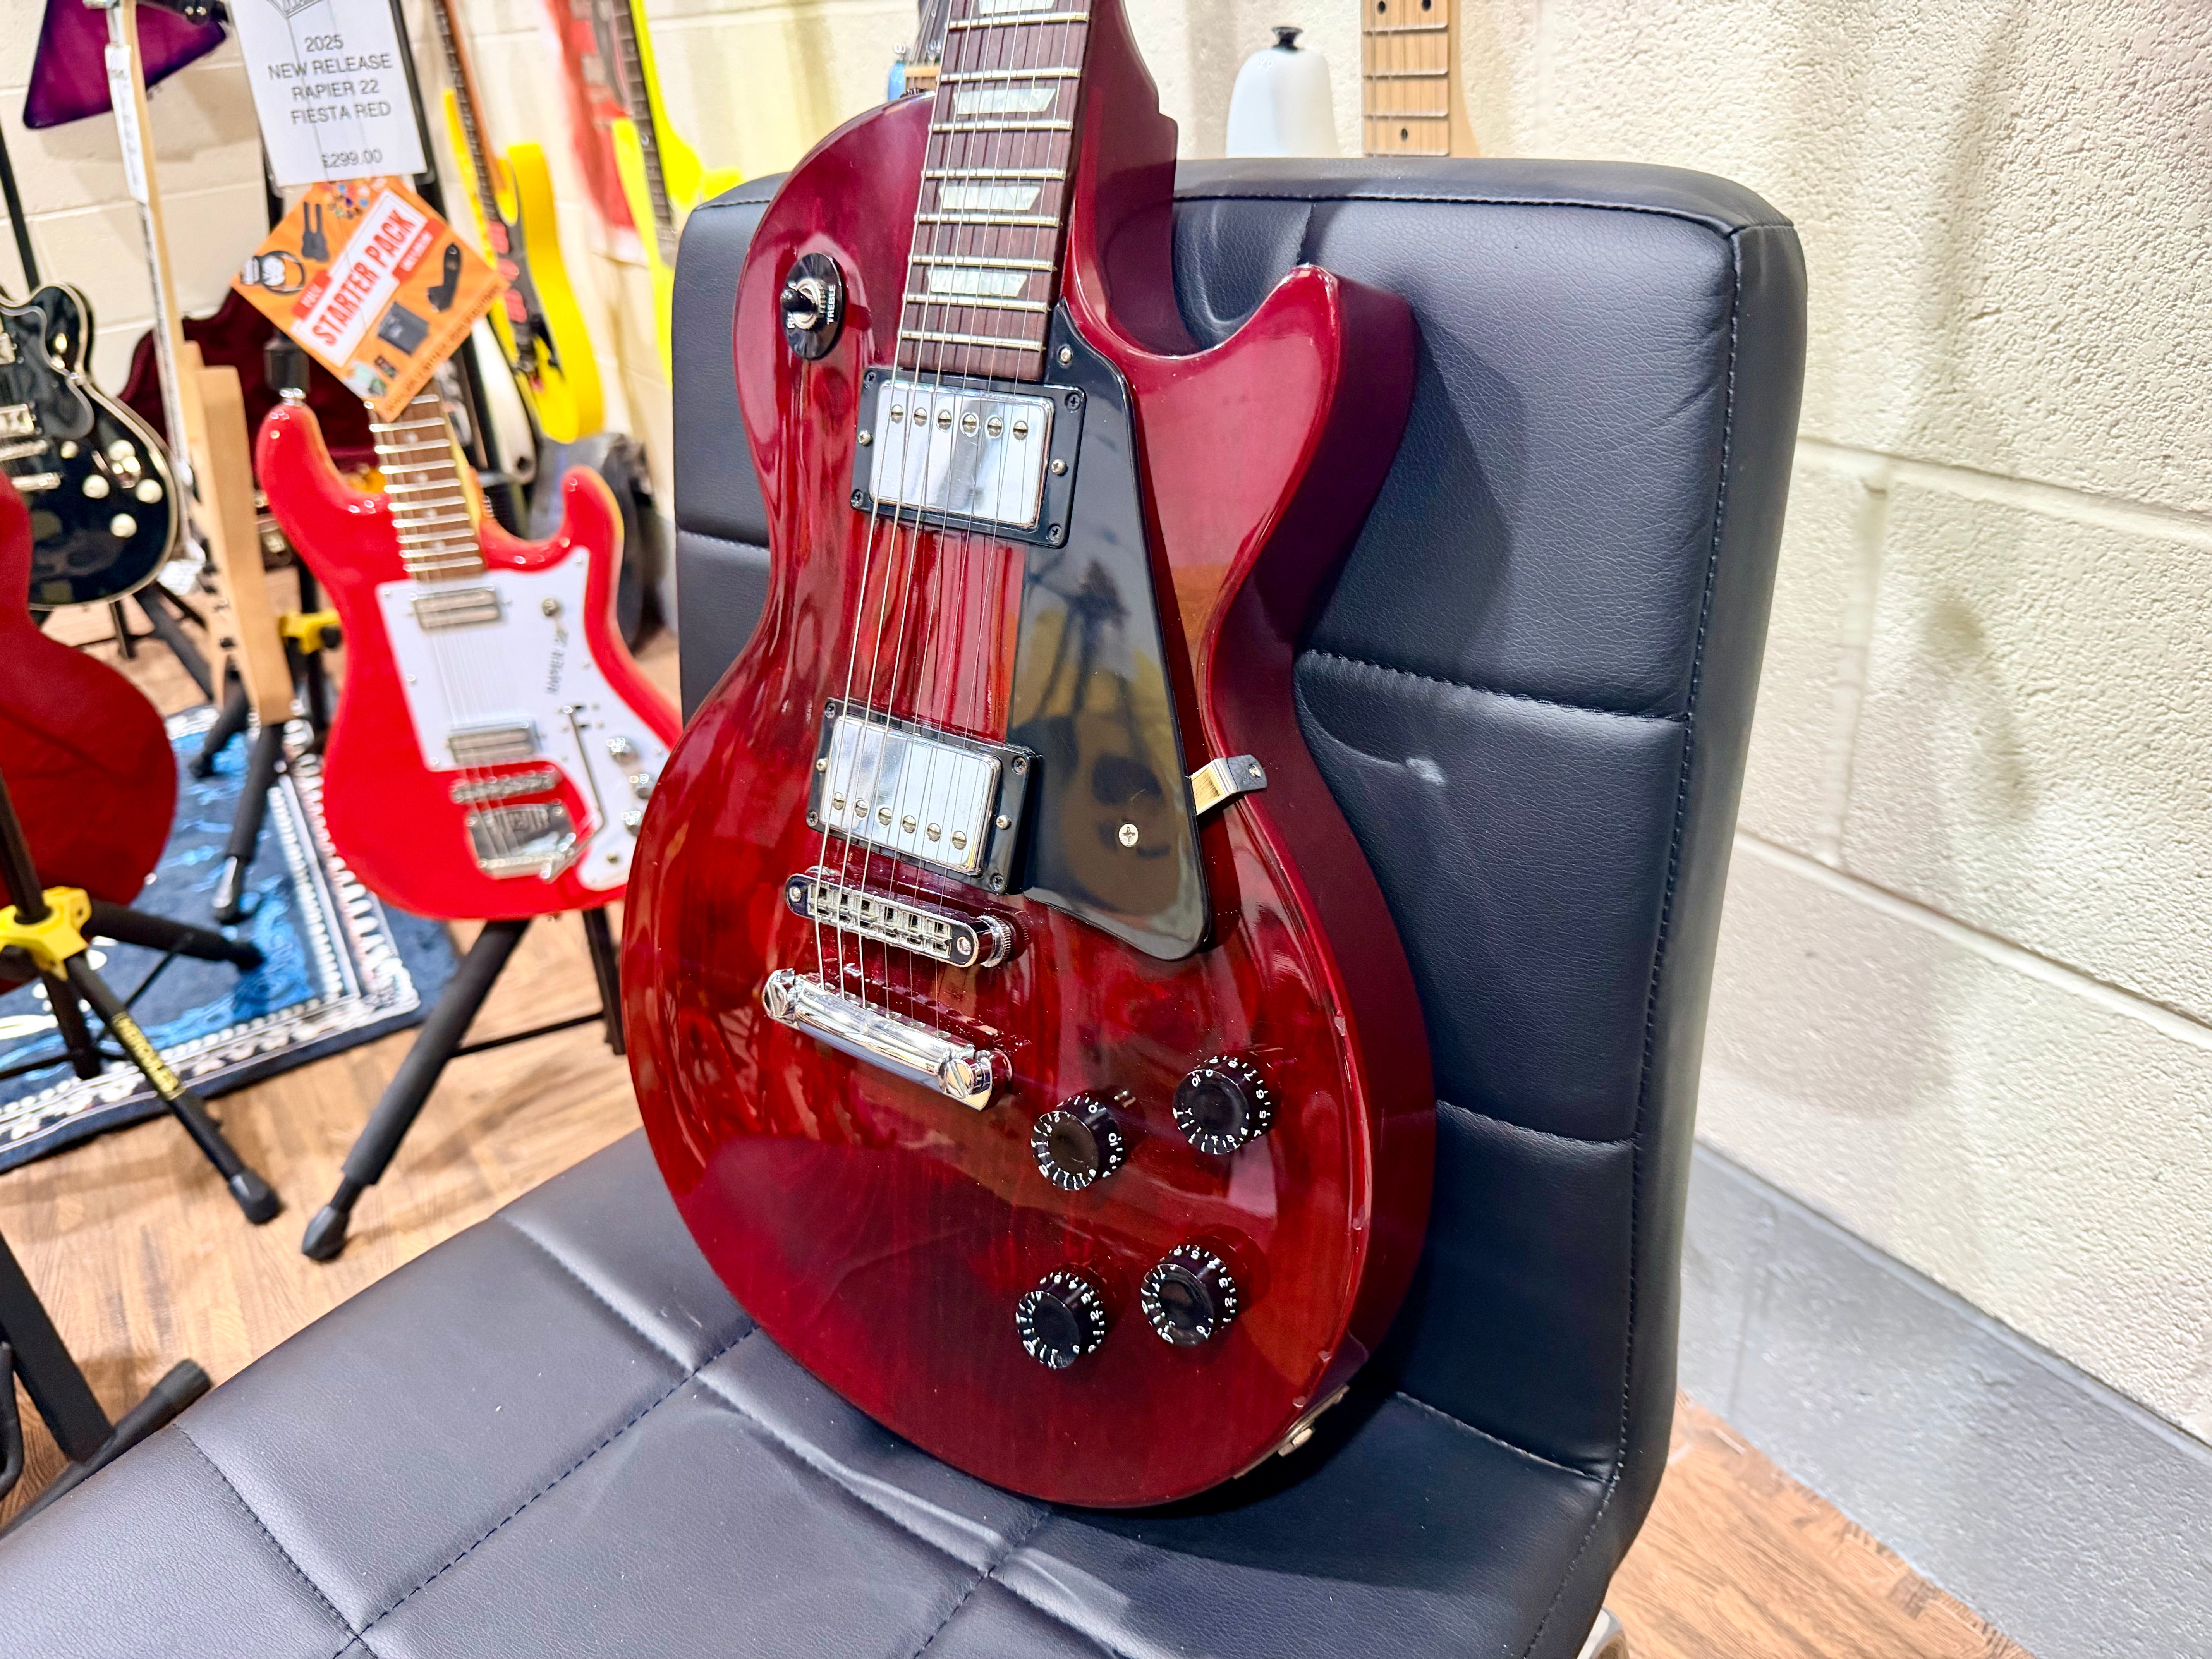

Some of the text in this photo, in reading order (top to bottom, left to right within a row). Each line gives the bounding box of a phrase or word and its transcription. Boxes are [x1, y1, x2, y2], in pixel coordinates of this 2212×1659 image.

[306, 34, 344, 52] 2025
[268, 53, 393, 80] NEW RELEASE
[292, 79, 380, 101] RAPIER 22
[291, 102, 391, 125] FIESTA RED
[322, 148, 383, 168] £299.00
[313, 209, 416, 346] STARTER PACK
[827, 285, 836, 325] TREBLE
